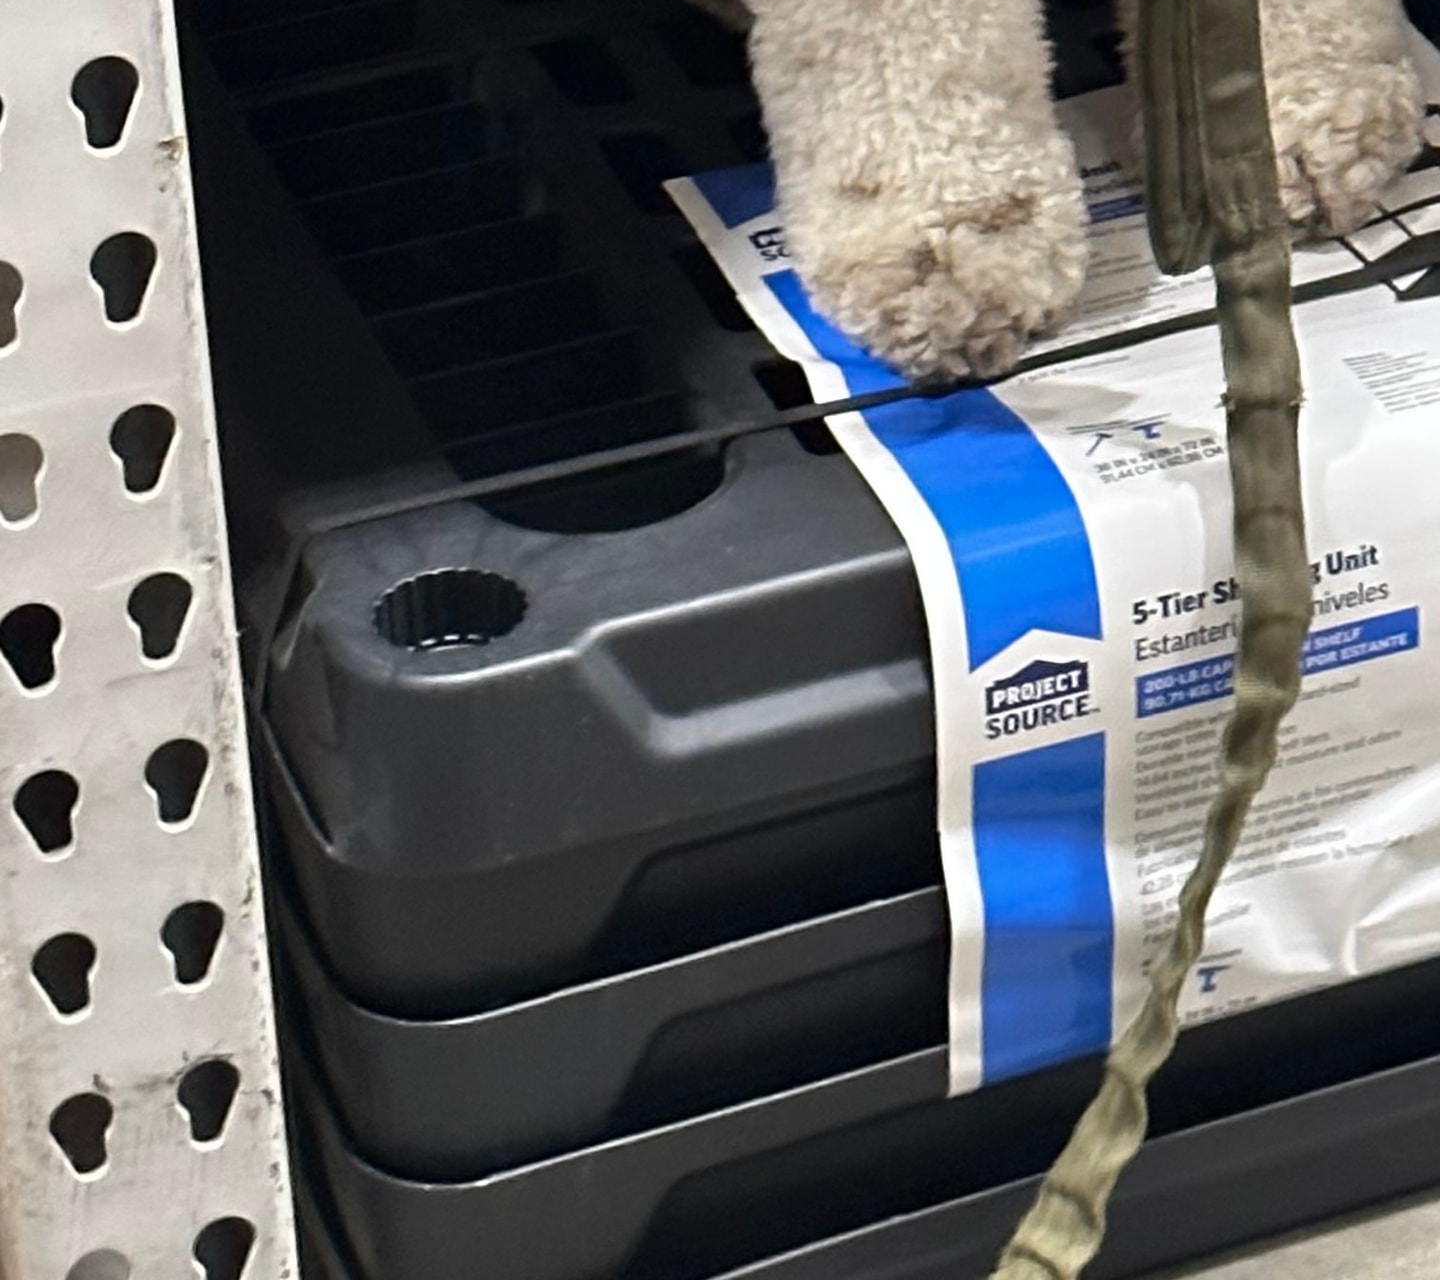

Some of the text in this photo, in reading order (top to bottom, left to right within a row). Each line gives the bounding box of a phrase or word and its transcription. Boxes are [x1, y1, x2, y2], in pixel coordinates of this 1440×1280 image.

[1132, 591, 1207, 626] 5-Tier
[1325, 545, 1380, 576] Unit
[992, 669, 1082, 709] PROJECT
[985, 693, 1091, 740] SOURCE
